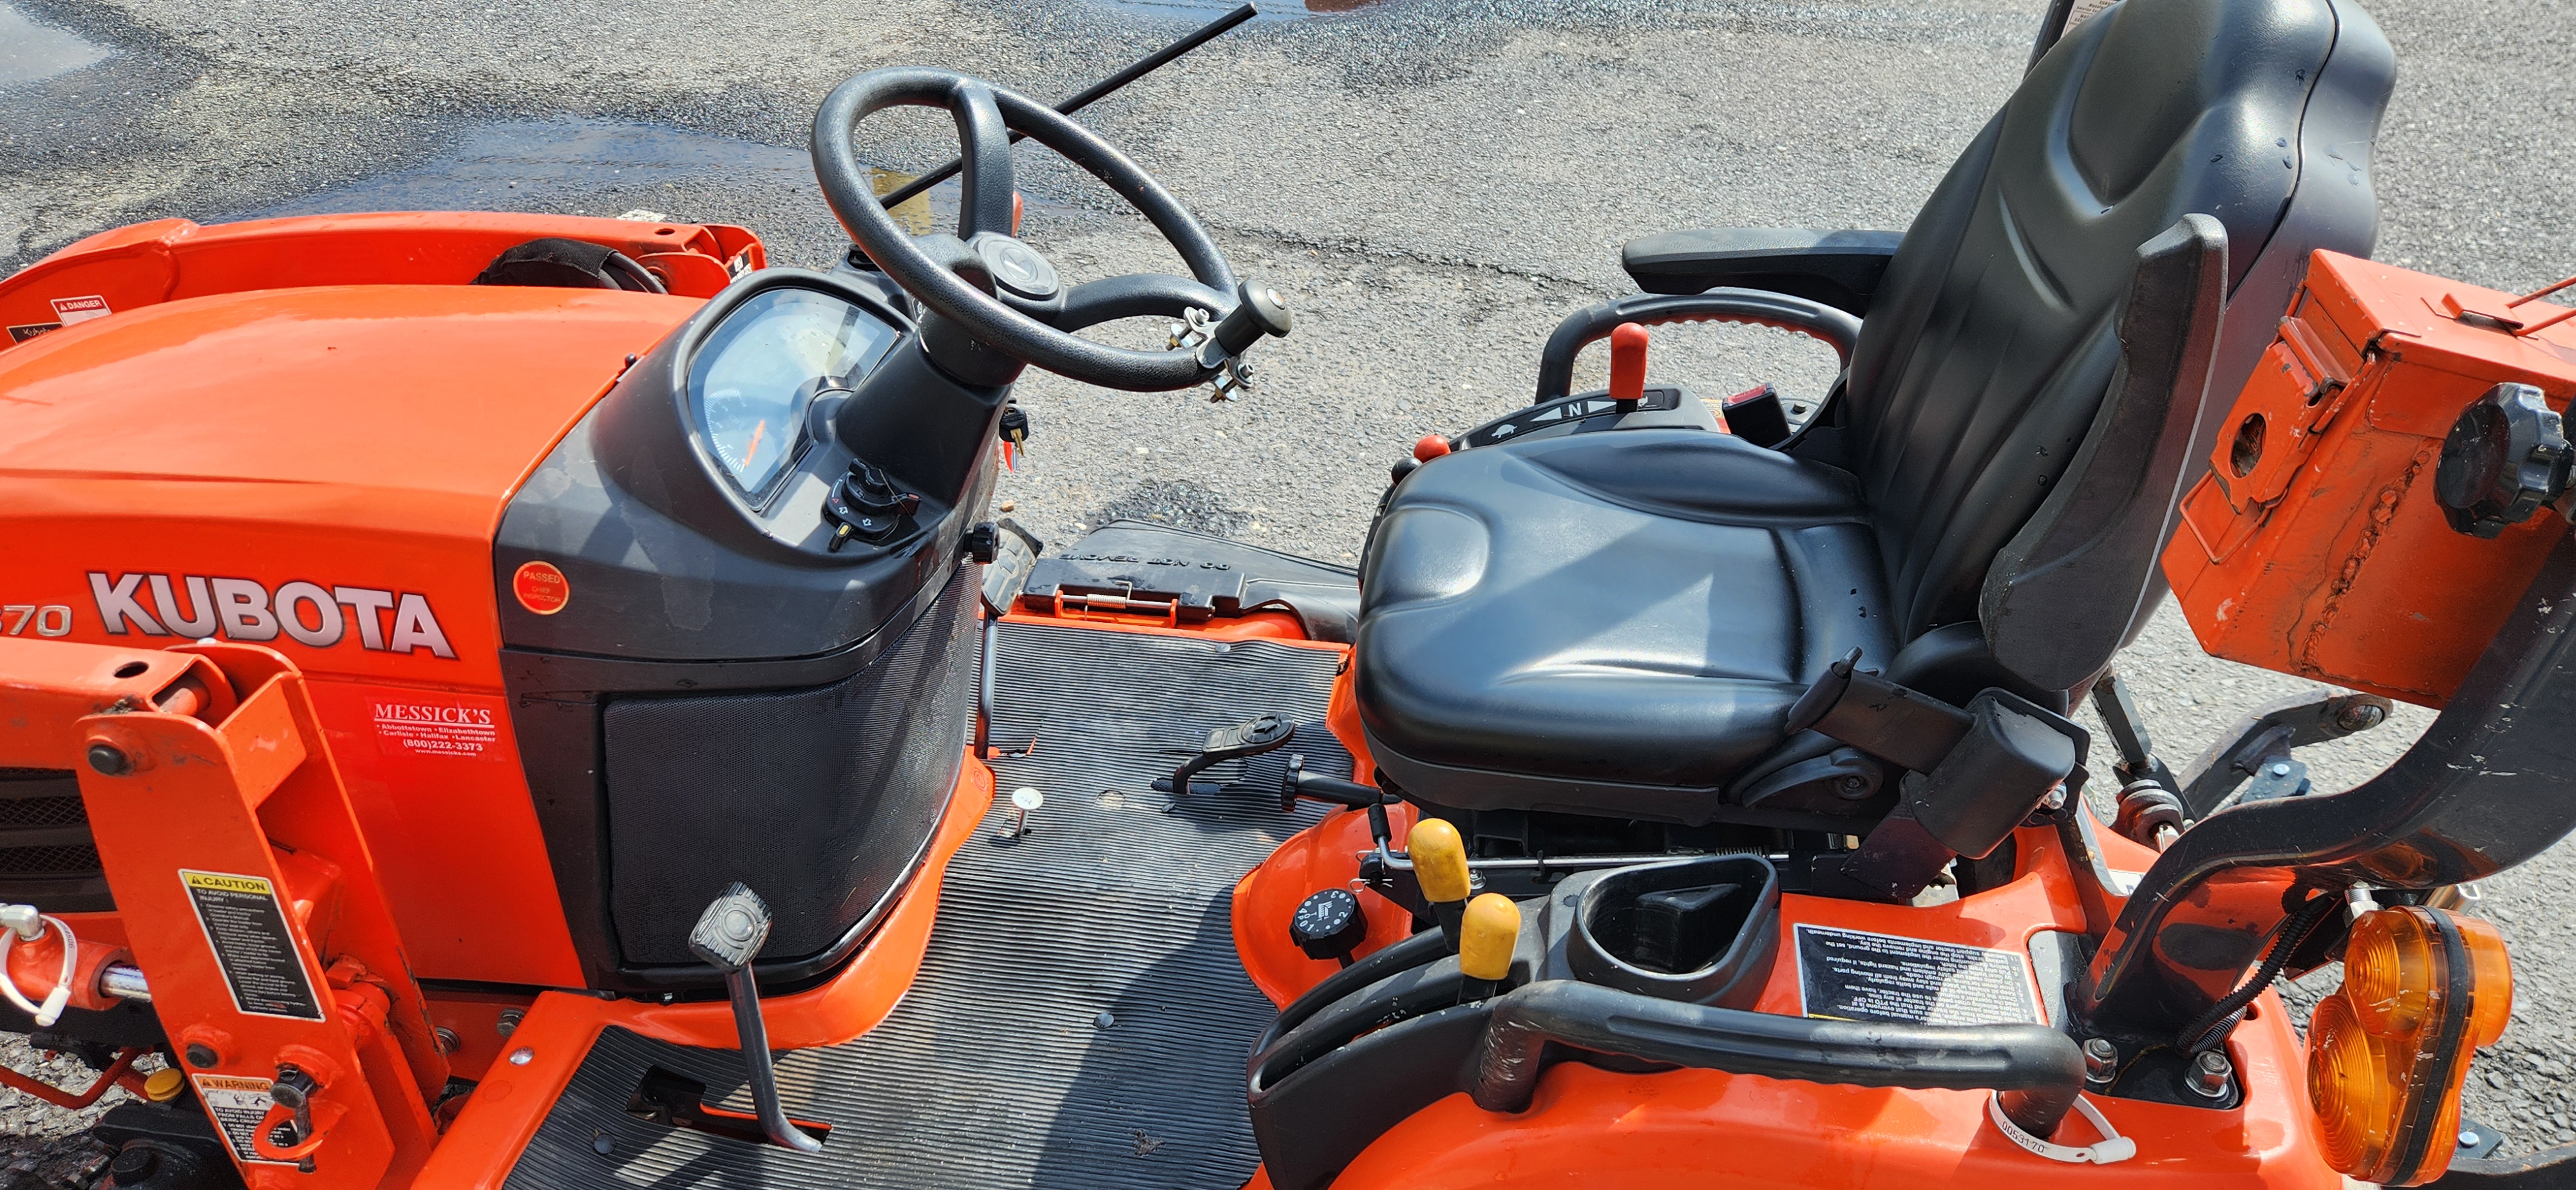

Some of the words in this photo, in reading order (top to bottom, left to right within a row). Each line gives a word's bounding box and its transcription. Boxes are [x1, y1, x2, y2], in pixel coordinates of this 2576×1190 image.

[66, 299, 102, 309] DANGER
[1568, 402, 1582, 417] N
[1059, 554, 1140, 563] REMOVE
[1147, 558, 1190, 567] NOT
[1200, 561, 1231, 571] DO
[523, 571, 561, 584] PASSED
[522, 592, 561, 603] INSPECTOR
[0, 605, 72, 637] 70
[88, 571, 460, 661] KUBOTA
[374, 703, 491, 724] MESSICK'S
[382, 724, 432, 732] Abbottstown
[439, 727, 495, 735] Elizabethtown
[403, 739, 483, 751] (800)222-3373
[204, 877, 266, 891] CAUTION
[230, 892, 268, 901] PERSONAL
[1307, 923, 1314, 932] 1
[1806, 930, 1841, 938] underneath.
[1888, 940, 1921, 949] implements
[1889, 950, 1920, 959] implement
[1900, 961, 1935, 970] regulations.
[1866, 977, 1895, 985] regularly.
[213, 1079, 269, 1090] WARNING
[2002, 1120, 2045, 1153] 0053170
